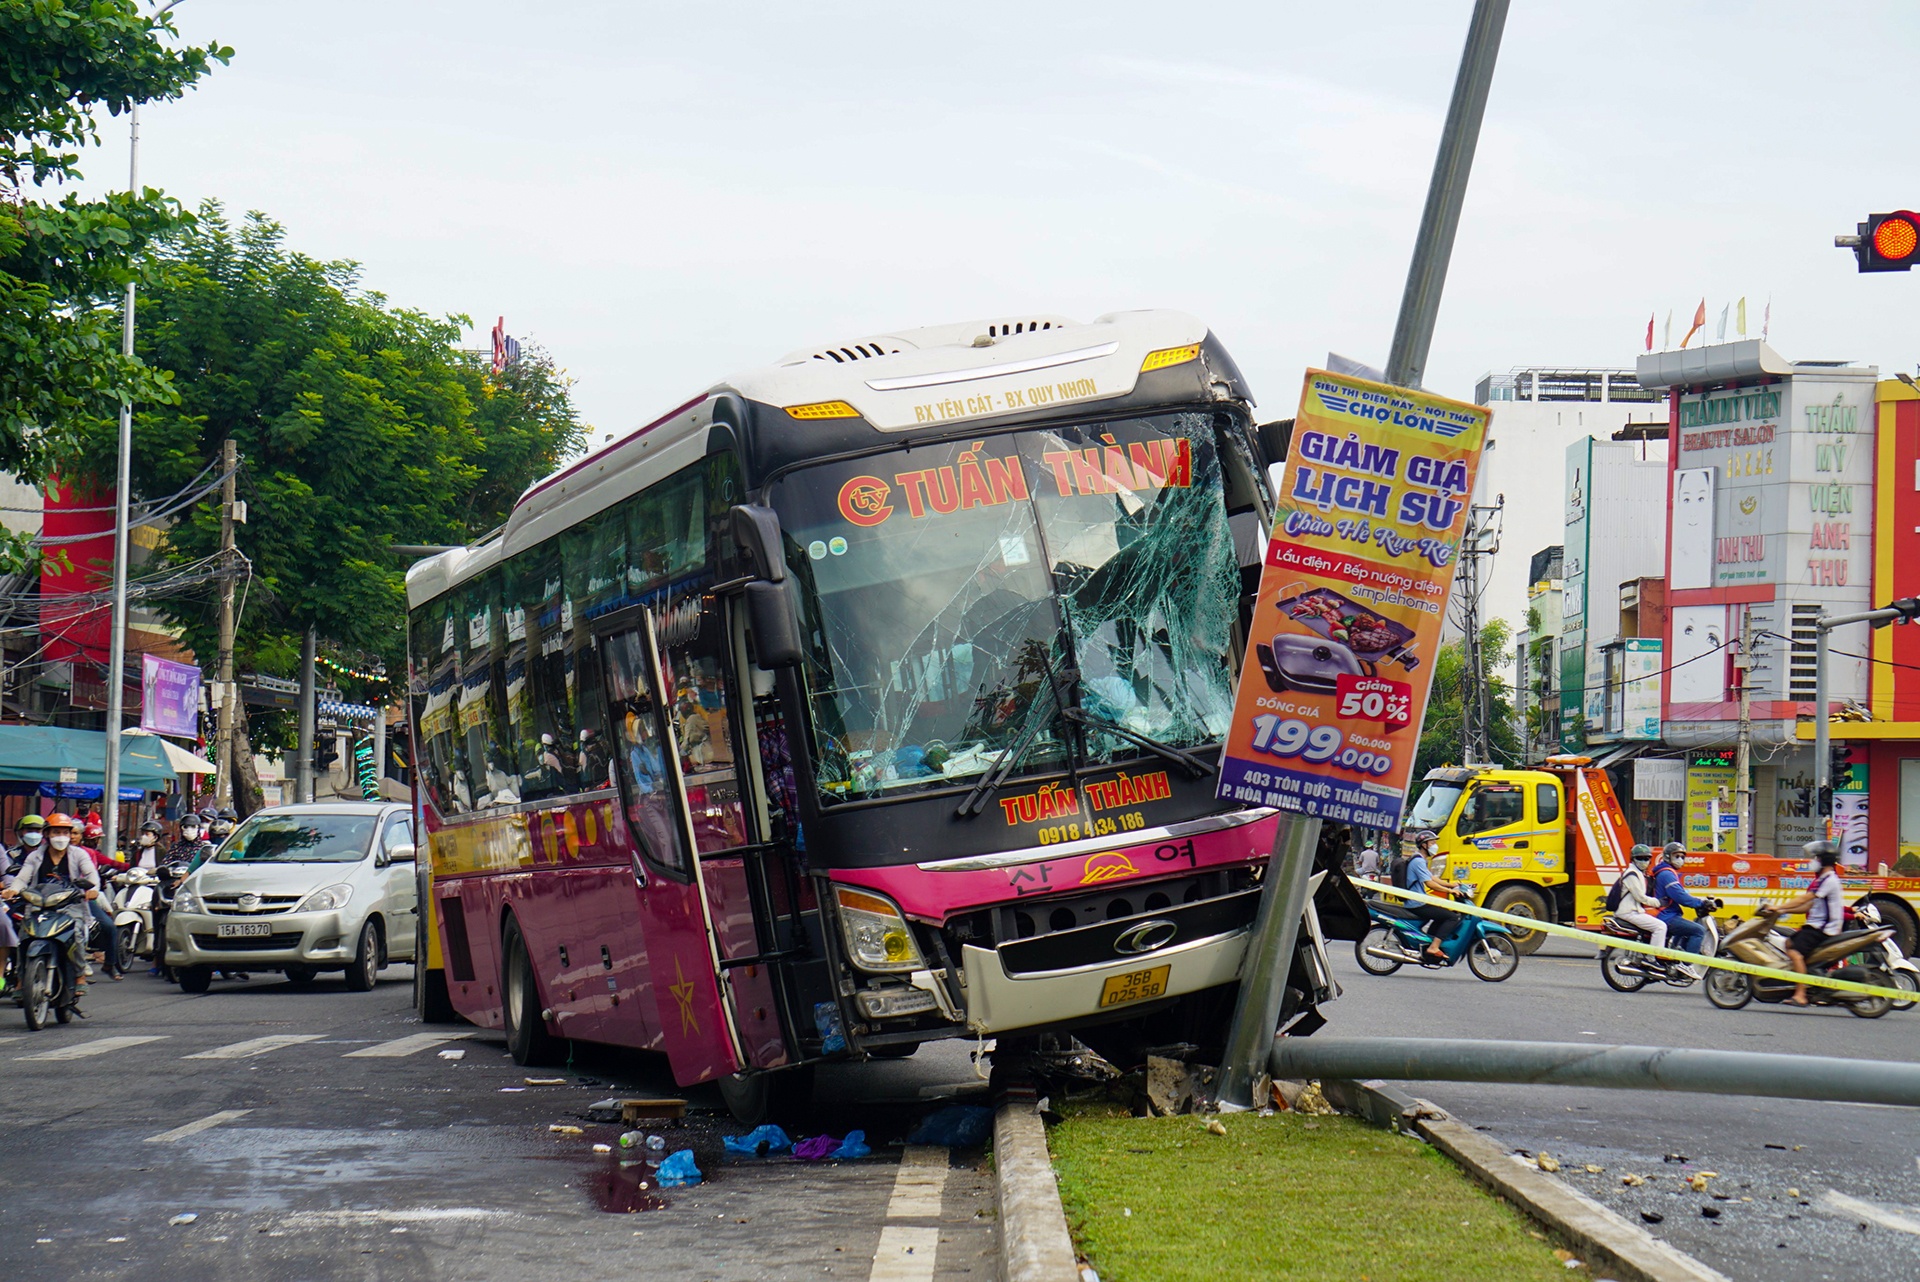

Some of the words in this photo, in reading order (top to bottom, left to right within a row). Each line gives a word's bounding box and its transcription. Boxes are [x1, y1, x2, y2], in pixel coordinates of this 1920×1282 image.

[936, 398, 965, 419] YÊN
[967, 393, 994, 414] CÁT
[1005, 391, 1026, 408] BX
[1028, 385, 1055, 406] QUY
[1057, 378, 1097, 400] NHƠN
[1314, 381, 1338, 393] SIÊU
[1341, 387, 1359, 399] THỊ
[1362, 392, 1388, 405] ĐIỆN
[1425, 406, 1445, 419] NỘI
[1348, 402, 1392, 425] CHỢ
[1393, 410, 1436, 433] LỚN
[1683, 429, 1733, 451] BEAUTY
[1734, 424, 1778, 446] SALON
[895, 441, 1029, 518] TUẤN
[1044, 433, 1192, 497] THÀNH
[1301, 432, 1400, 478] GIẢM
[1407, 456, 1468, 494] GIÁ
[1293, 466, 1392, 517] LỊCH
[1399, 489, 1464, 531] SỬ
[1809, 478, 1853, 518] VIỆN
[1284, 510, 1333, 537] Chào
[1337, 518, 1370, 544] Hè
[1373, 527, 1419, 557] Rực
[1810, 522, 1850, 550] ANH
[1717, 536, 1741, 564] ANH
[1276, 549, 1301, 564] Lẩu
[1302, 555, 1332, 571] điện
[1343, 563, 1369, 580] Bếp
[1370, 571, 1412, 591] nướng
[1414, 579, 1443, 595] điện
[1351, 584, 1439, 614] simplehome
[1355, 679, 1393, 693] Giảm
[1256, 696, 1295, 713] ĐỒNG
[1297, 705, 1320, 718] GIÁ
[1339, 692, 1408, 721] 50%
[1349, 733, 1392, 751] 500.000
[1000, 781, 1080, 826] TUẤN
[1084, 770, 1172, 812] THÀNH
[1221, 783, 1231, 797] P.
[1234, 786, 1262, 803] HÒA
[1306, 802, 1319, 815] Q.
[1322, 802, 1351, 821] LIÊN
[1243, 770, 1270, 787] 403
[1274, 774, 1300, 792] TÔN
[1303, 779, 1331, 799] ĐỨC
[1335, 785, 1378, 809] THẮNG
[1637, 776, 1659, 798] THÁI
[1662, 780, 1682, 799] LAN
[1777, 800, 1809, 818] AN
[1038, 824, 1081, 845] 0918
[1118, 812, 1145, 831] 186
[1154, 839, 1196, 867] 여
[1010, 864, 1052, 895] 산
[1717, 874, 1735, 888] HỘ
[1738, 876, 1768, 888] GIAO
[1779, 875, 1815, 888] THÔN
[1109, 983, 1160, 1004] 025.58
[1123, 971, 1152, 988] 36B
